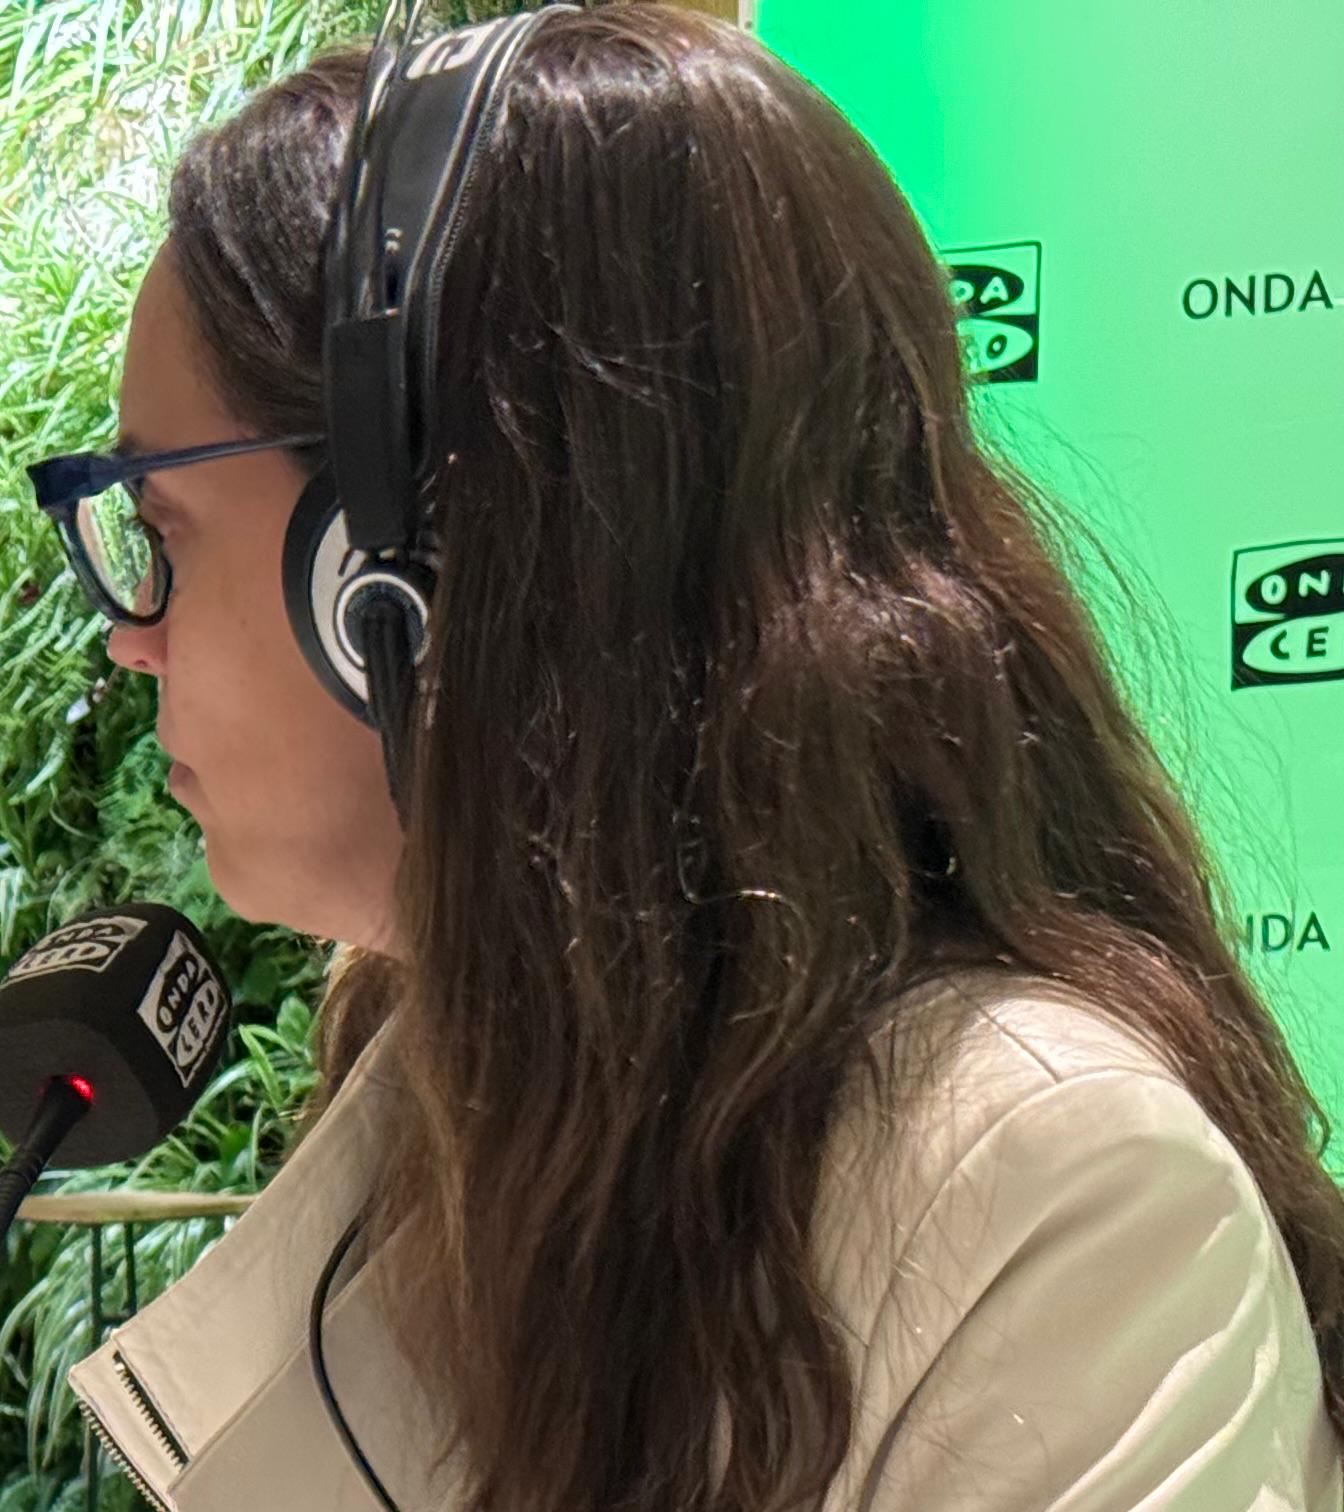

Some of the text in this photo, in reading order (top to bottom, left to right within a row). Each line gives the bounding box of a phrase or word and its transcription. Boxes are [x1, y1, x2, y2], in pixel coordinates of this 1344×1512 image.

[948, 276, 1009, 305] DA
[1182, 269, 1334, 320] ONDA
[1260, 569, 1334, 605] ON
[1270, 626, 1330, 660] CE
[159, 960, 199, 1026] ONDA
[180, 988, 215, 1053] CERO
